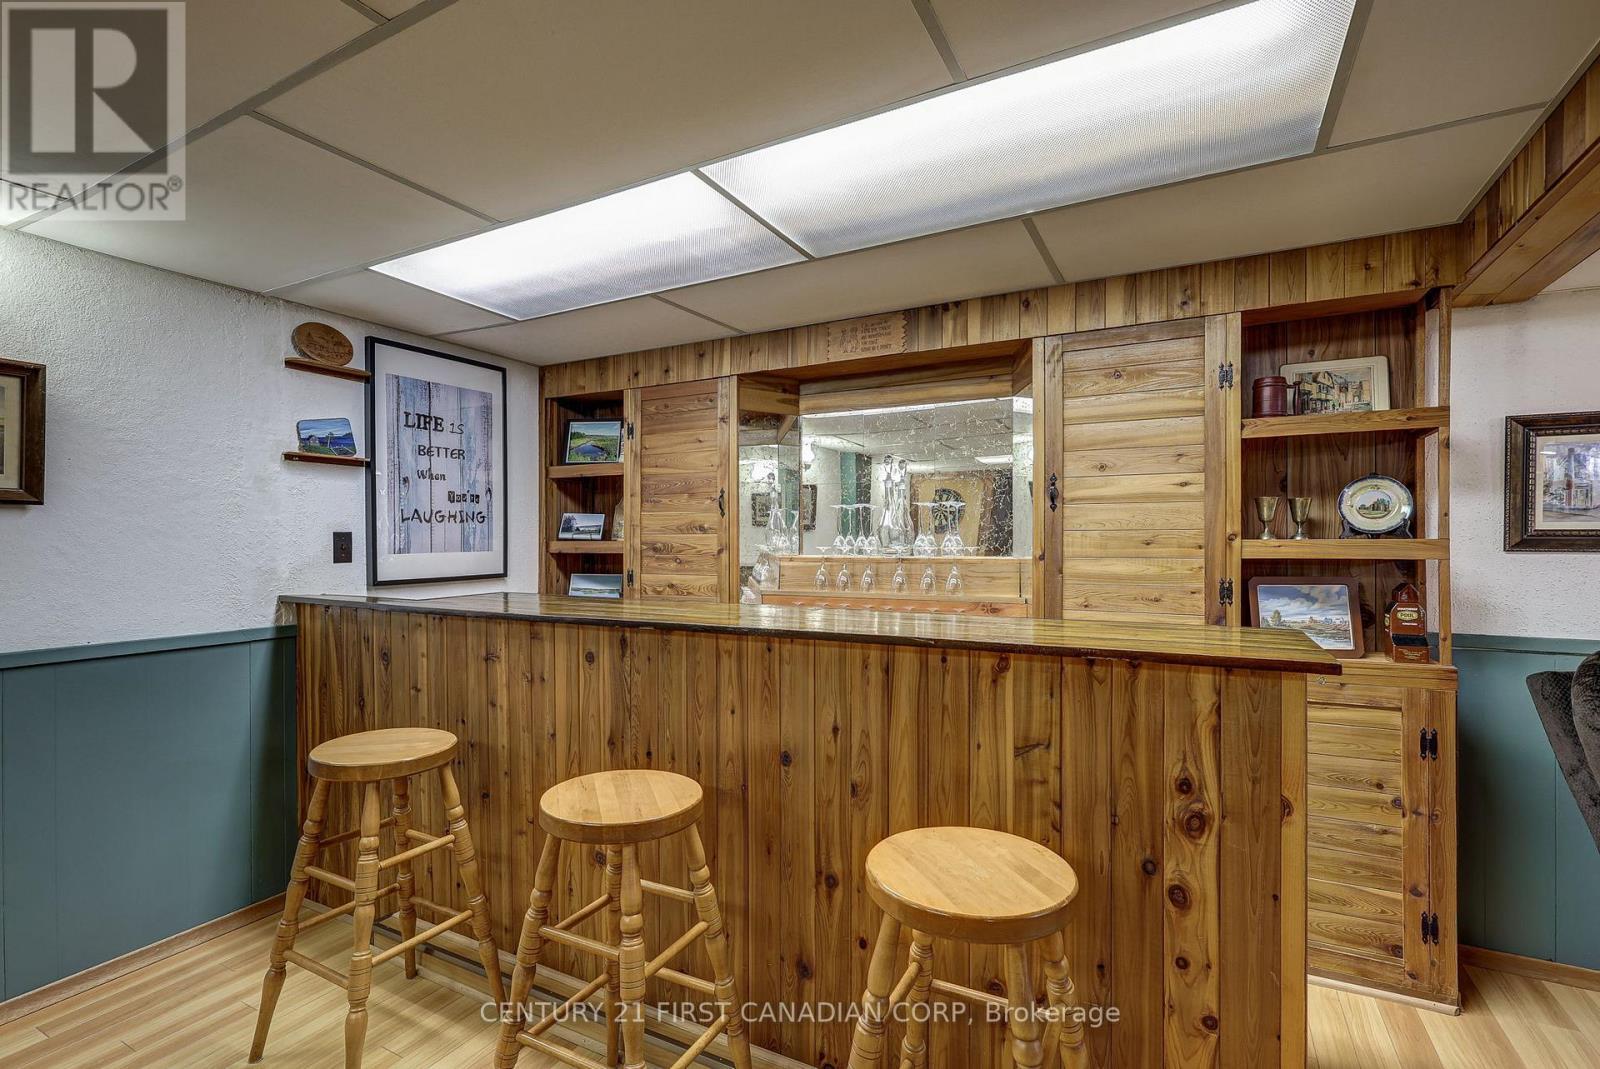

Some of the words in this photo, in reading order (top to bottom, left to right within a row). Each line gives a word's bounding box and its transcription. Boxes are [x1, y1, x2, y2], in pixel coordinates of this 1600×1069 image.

[403, 411, 444, 432] LIFE
[418, 444, 466, 460] BETTER
[417, 468, 447, 481] When
[400, 508, 487, 524] LAUGHING
